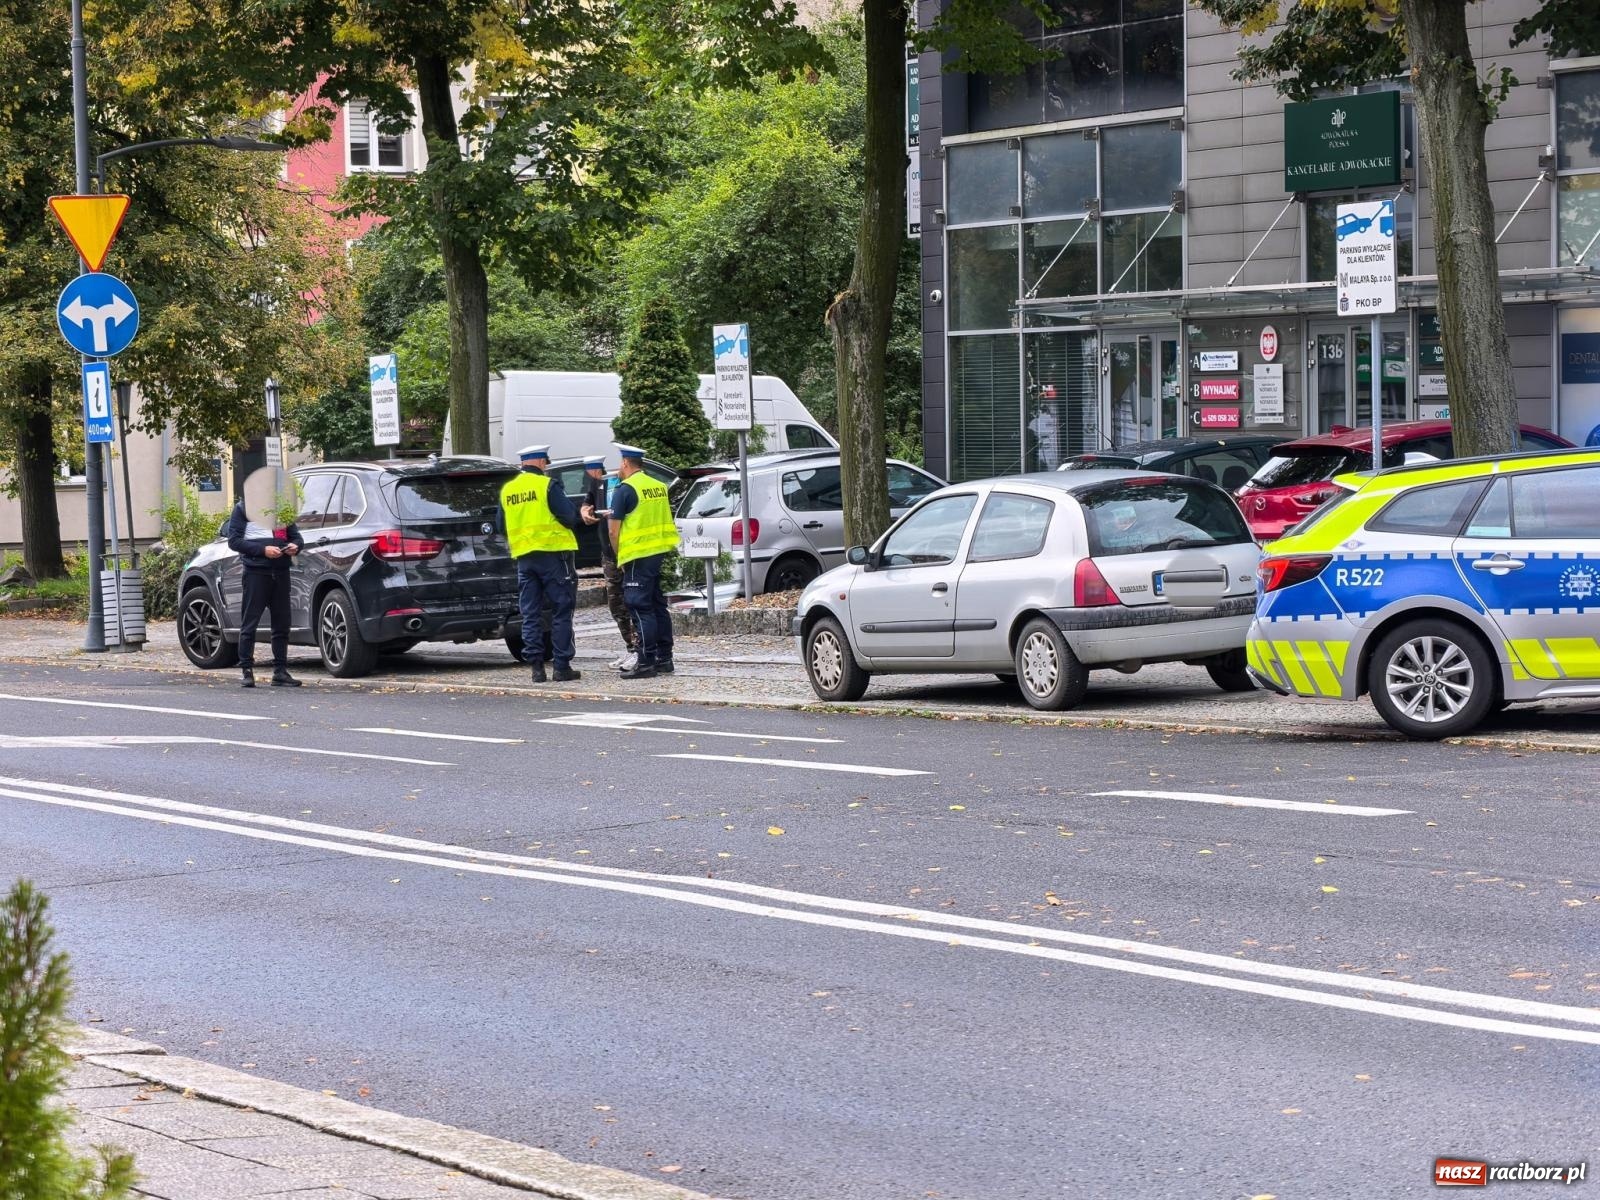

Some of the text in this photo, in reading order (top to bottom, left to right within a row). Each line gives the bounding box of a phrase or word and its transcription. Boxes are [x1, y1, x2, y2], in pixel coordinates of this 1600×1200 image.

[1328, 140, 1350, 149] POLSKA
[1287, 156, 1393, 176] KANCELARIE ADWOKACKIE
[1339, 243, 1392, 255] PARKING WYŁĄCZNIE
[1346, 256, 1358, 264] DLA
[1349, 275, 1370, 285] MALAYA
[1370, 274, 1379, 285] Sp.
[1355, 297, 1382, 308] PKO BP
[1321, 344, 1344, 360] 13b
[1192, 355, 1200, 369] A
[1193, 384, 1200, 397] B
[1202, 384, 1237, 397] WYNAJMĘ
[1193, 411, 1201, 424] C
[506, 490, 537, 506] POLICJA
[1336, 568, 1385, 588] R522
